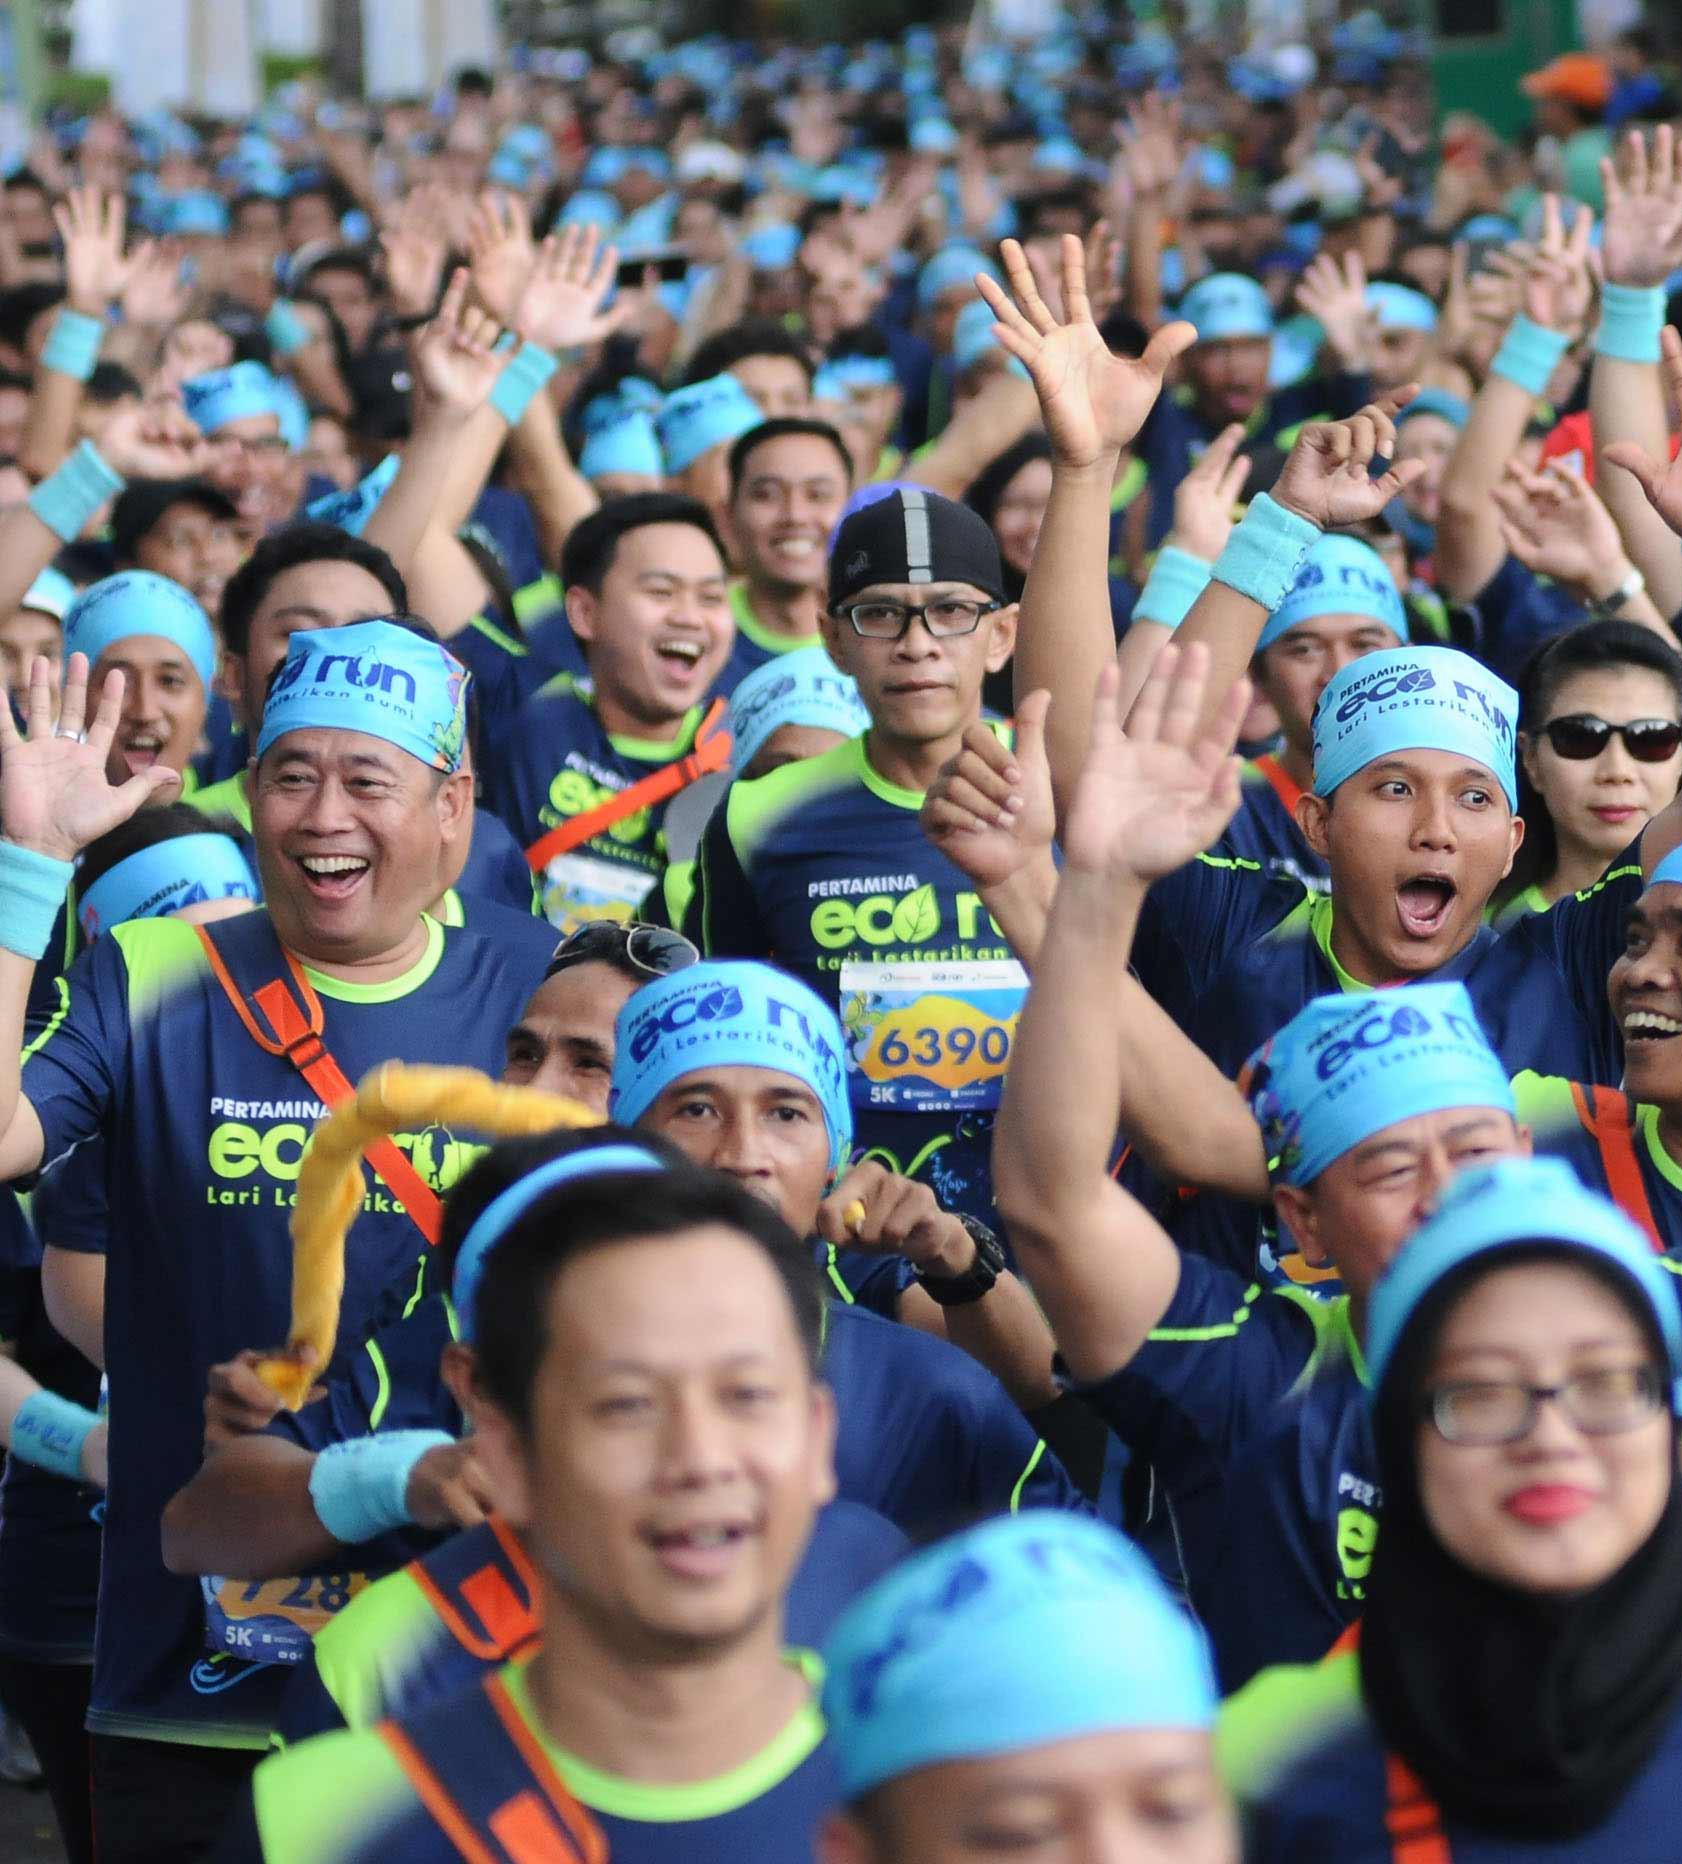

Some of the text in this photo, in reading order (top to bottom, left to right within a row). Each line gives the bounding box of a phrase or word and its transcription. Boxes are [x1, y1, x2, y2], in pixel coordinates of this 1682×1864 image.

[315, 654, 416, 704] run
[1340, 663, 1420, 701] PERTAMINA
[364, 693, 415, 720] Bumi
[1336, 668, 1437, 722] eco
[1338, 713, 1368, 741] Lari
[808, 874, 918, 898] PERTAMINA
[810, 883, 941, 948] eco
[879, 1026, 1010, 1067] 6390
[870, 1086, 897, 1104] 5K
[207, 1186, 261, 1206] Lari
[225, 1626, 254, 1648] 5K
